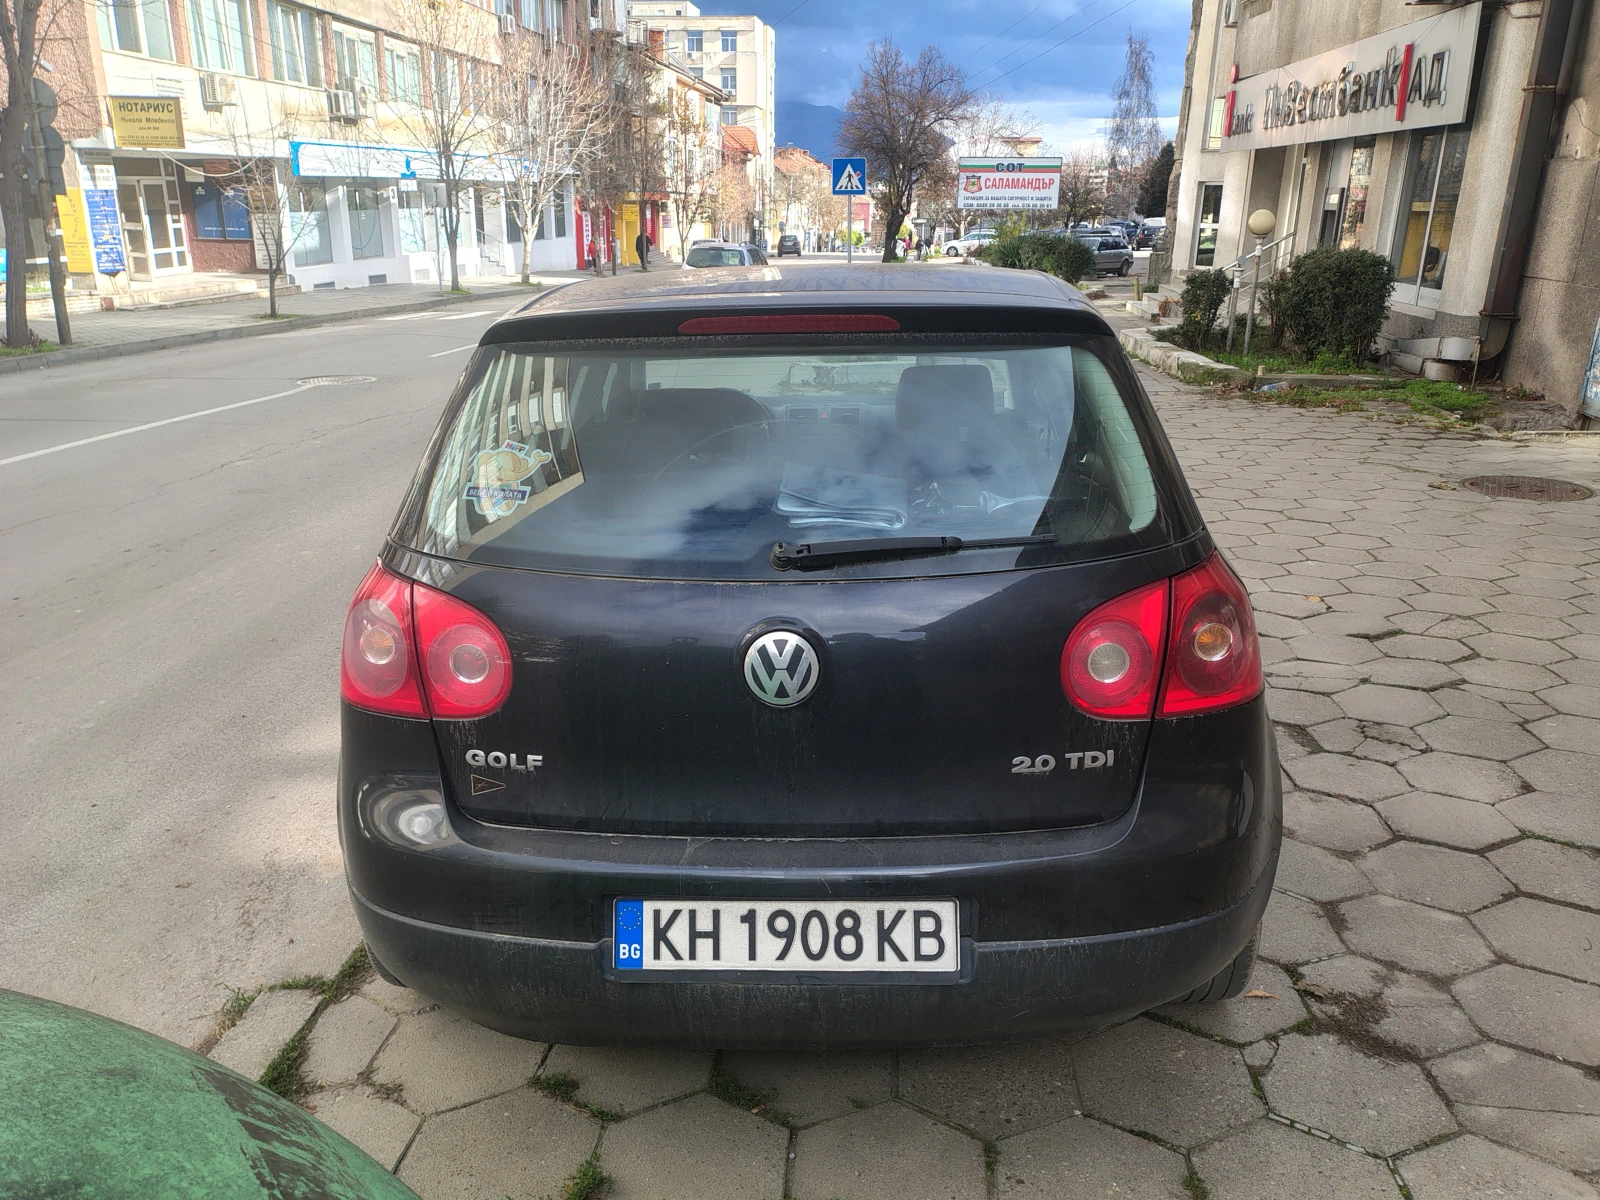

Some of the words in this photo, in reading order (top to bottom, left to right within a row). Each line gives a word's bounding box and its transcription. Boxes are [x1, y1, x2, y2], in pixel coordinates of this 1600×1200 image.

[118, 101, 174, 113] НОТАРИУС
[120, 116, 143, 124] Никола
[995, 162, 1025, 173] СОТ
[984, 177, 1055, 191] САЛАМАНДЪР
[504, 441, 526, 453] HiPP
[468, 488, 487, 496] БЕБЕ
[493, 490, 522, 499] КОЛАТА
[465, 749, 543, 772] GOLF
[1065, 749, 1115, 770] TDI
[653, 909, 720, 961] KH
[740, 909, 864, 961] 1908
[877, 909, 945, 962] KB
[619, 944, 641, 959] BG
